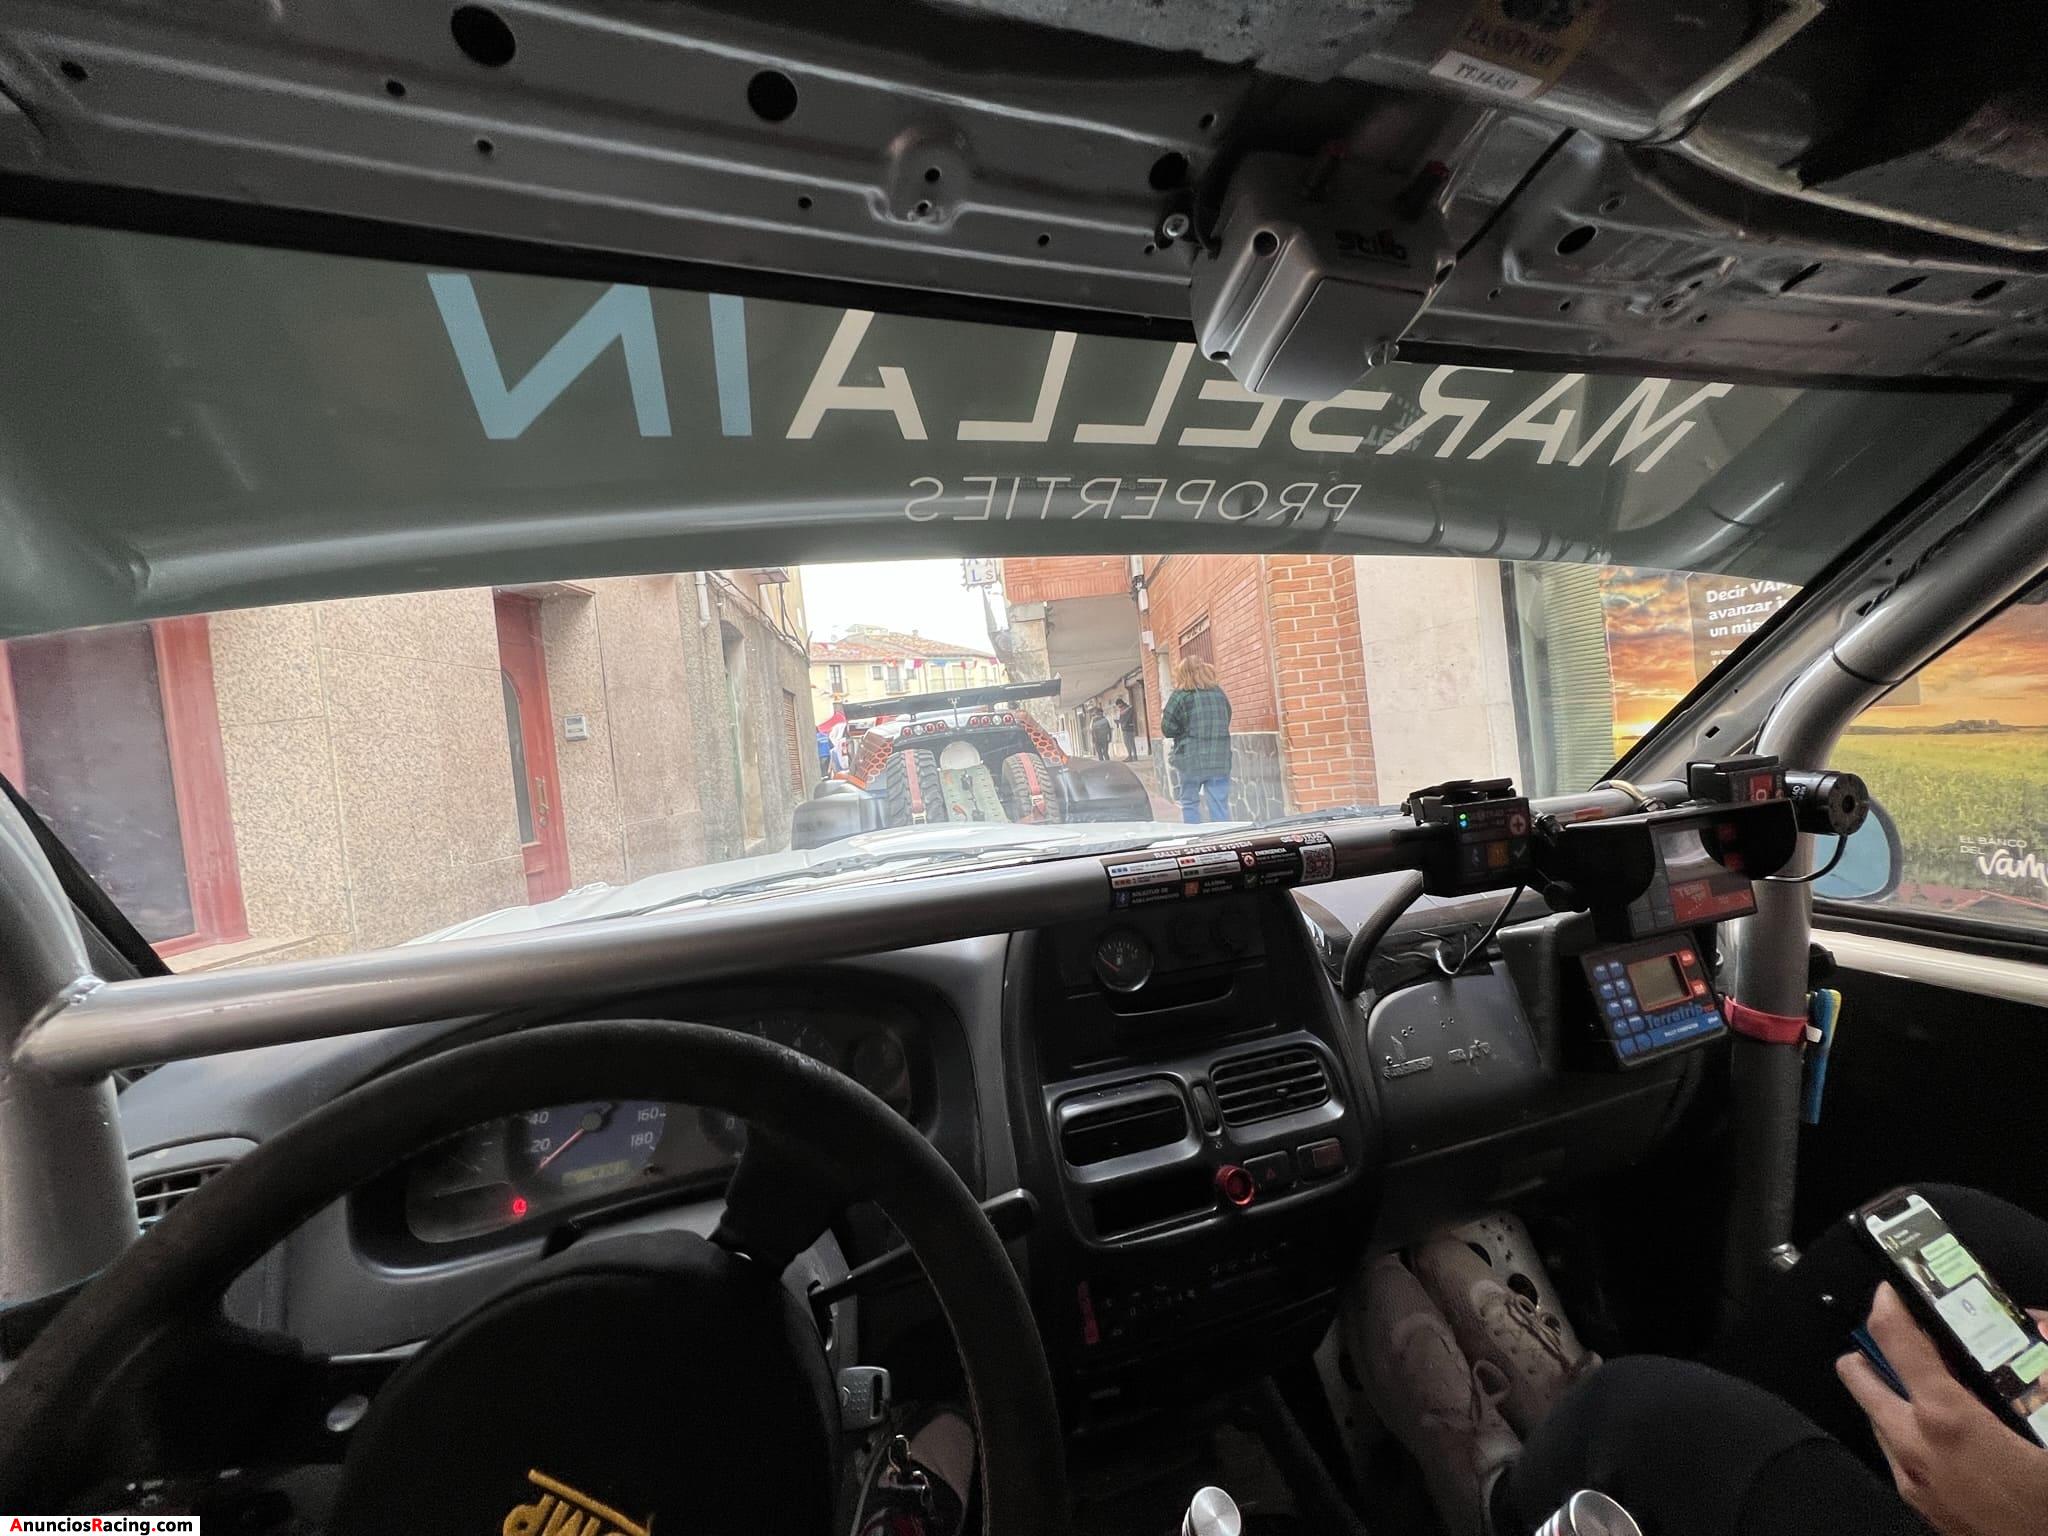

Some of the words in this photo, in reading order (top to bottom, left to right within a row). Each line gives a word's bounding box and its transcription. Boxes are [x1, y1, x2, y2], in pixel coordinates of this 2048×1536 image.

[1706, 584, 1748, 603] Decir
[1708, 599, 1773, 621] avanzar
[1710, 626, 1728, 638] un
[1960, 835, 1975, 844] EL
[1978, 836, 2028, 849] BANCO
[1153, 849, 1181, 860] RALLY
[1184, 845, 1219, 856] SAFETY
[1220, 840, 1253, 851] SYSTEM
[1960, 845, 1986, 856] DEL
[637, 1107, 659, 1122] 160
[531, 1138, 551, 1153] 20
[630, 1131, 654, 1148] 180
